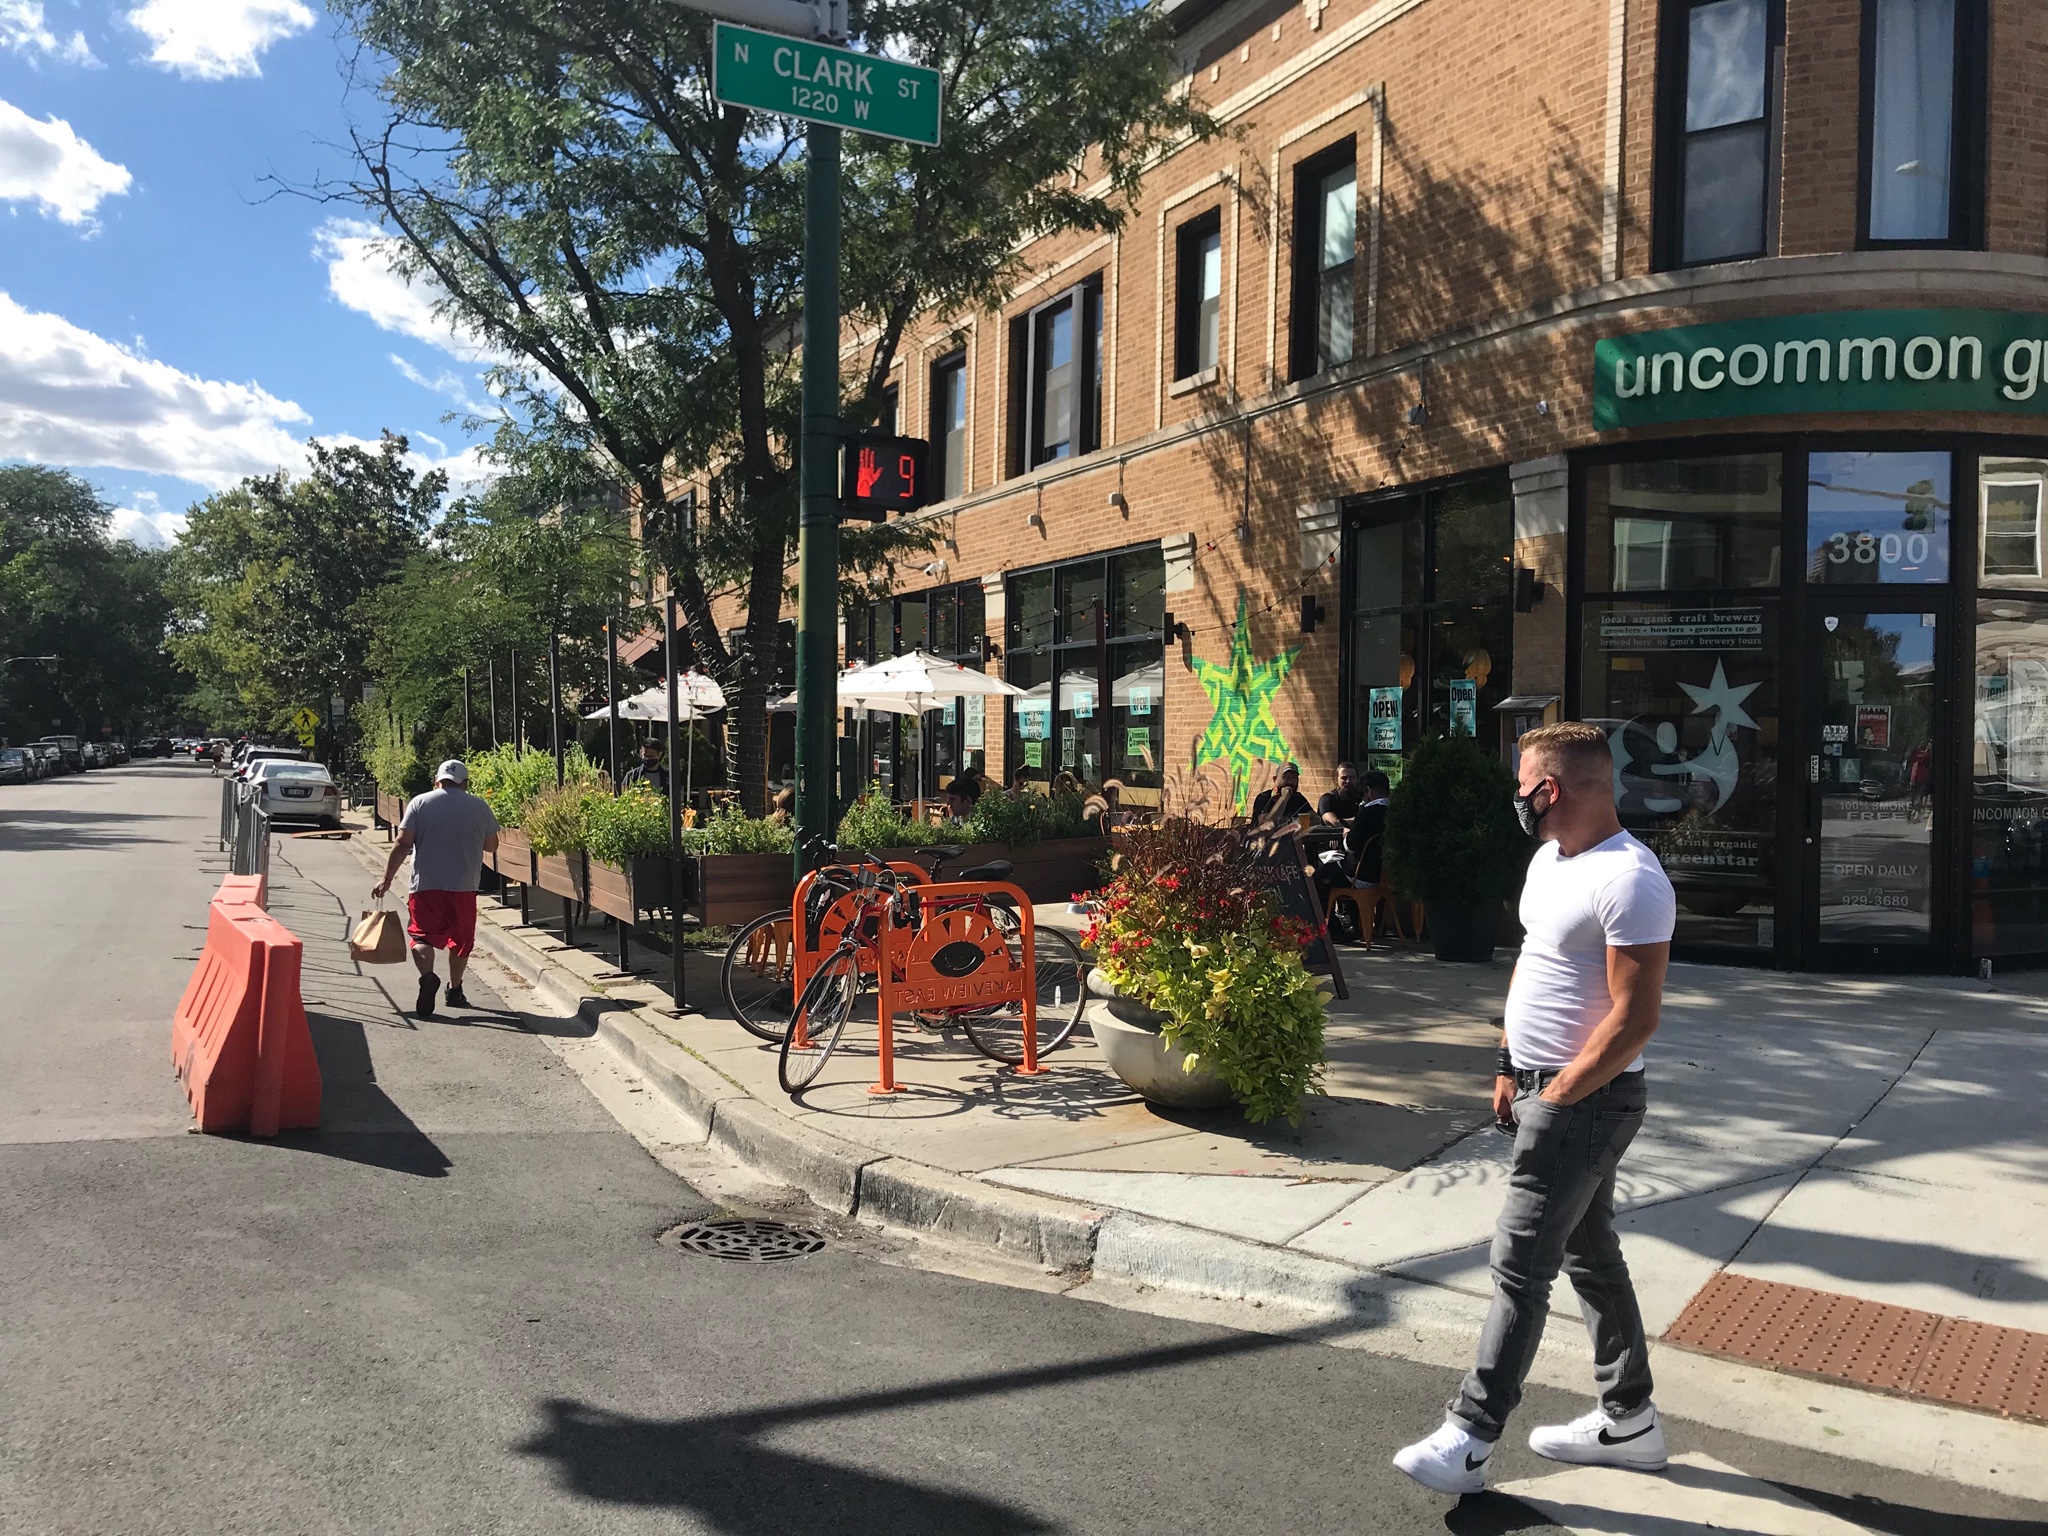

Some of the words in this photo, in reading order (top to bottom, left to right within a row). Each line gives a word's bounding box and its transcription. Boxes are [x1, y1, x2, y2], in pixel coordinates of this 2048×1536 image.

[734, 42, 749, 64] N
[773, 47, 874, 95] CLARK
[898, 79, 920, 100] ST
[792, 86, 838, 114] 1220
[854, 99, 869, 120] W
[1615, 336, 1982, 398] uncommon
[899, 455, 914, 497] 9
[1828, 532, 1929, 564] 3800
[1601, 615, 1626, 624] local
[1633, 614, 1673, 625] organic
[1679, 613, 1707, 623] craft
[1713, 613, 1762, 624] brewery
[1604, 627, 1641, 635] growlers
[1650, 626, 1684, 634] howlers
[1694, 626, 1733, 634] growlers
[1746, 626, 1758, 634] go
[1600, 637, 1631, 646] brewed
[1633, 637, 1651, 646] here
[1657, 638, 1668, 646] no
[1670, 637, 1695, 647] gmo's
[1699, 637, 1736, 647] brewery
[1738, 637, 1762, 646] tours
[1452, 687, 1475, 703] Open!
[1373, 700, 1398, 718] OPEN!
[1823, 725, 1849, 733] ATM
[1840, 801, 1869, 810] 100%
[1872, 801, 1913, 811] SMOKE
[1846, 811, 1906, 820] FREE
[1675, 838, 1710, 847] drink
[1713, 840, 1759, 850] organic
[1659, 853, 1759, 867] greenstar
[1834, 864, 1874, 876] OPEN
[1878, 864, 1918, 876] DAILY
[1842, 895, 1909, 906] 929-3680
